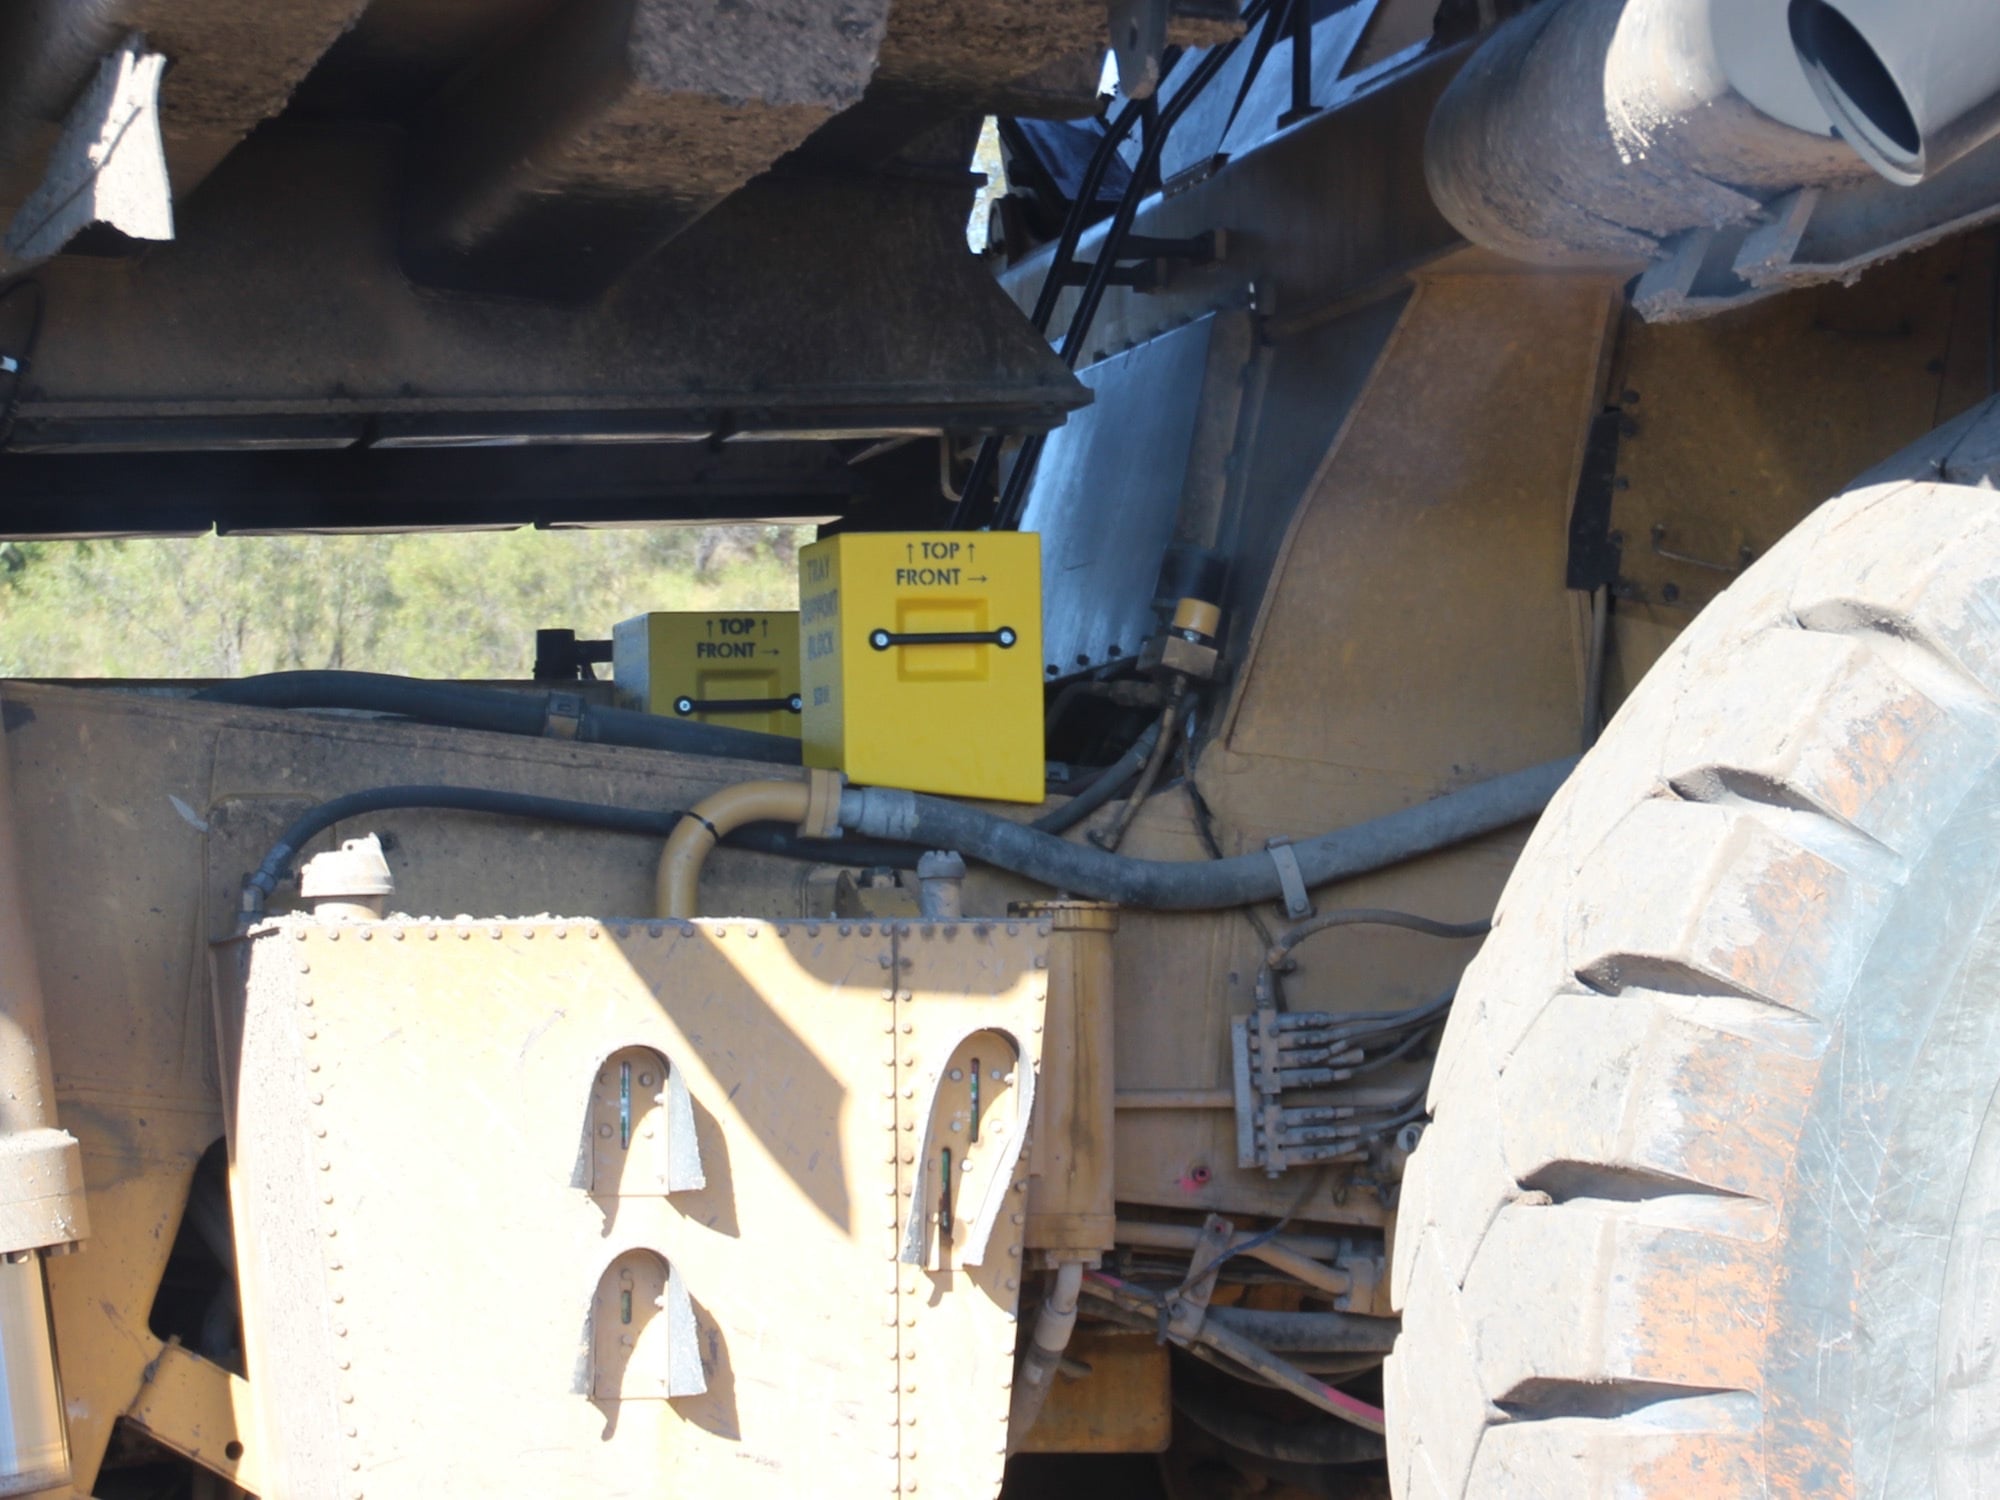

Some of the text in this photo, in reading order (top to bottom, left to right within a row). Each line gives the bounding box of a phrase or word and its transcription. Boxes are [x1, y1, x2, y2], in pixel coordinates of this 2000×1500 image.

[921, 542, 960, 560] TOP
[896, 568, 961, 586] FRONT
[719, 618, 756, 635] TOP
[696, 643, 756, 658] FRONT
